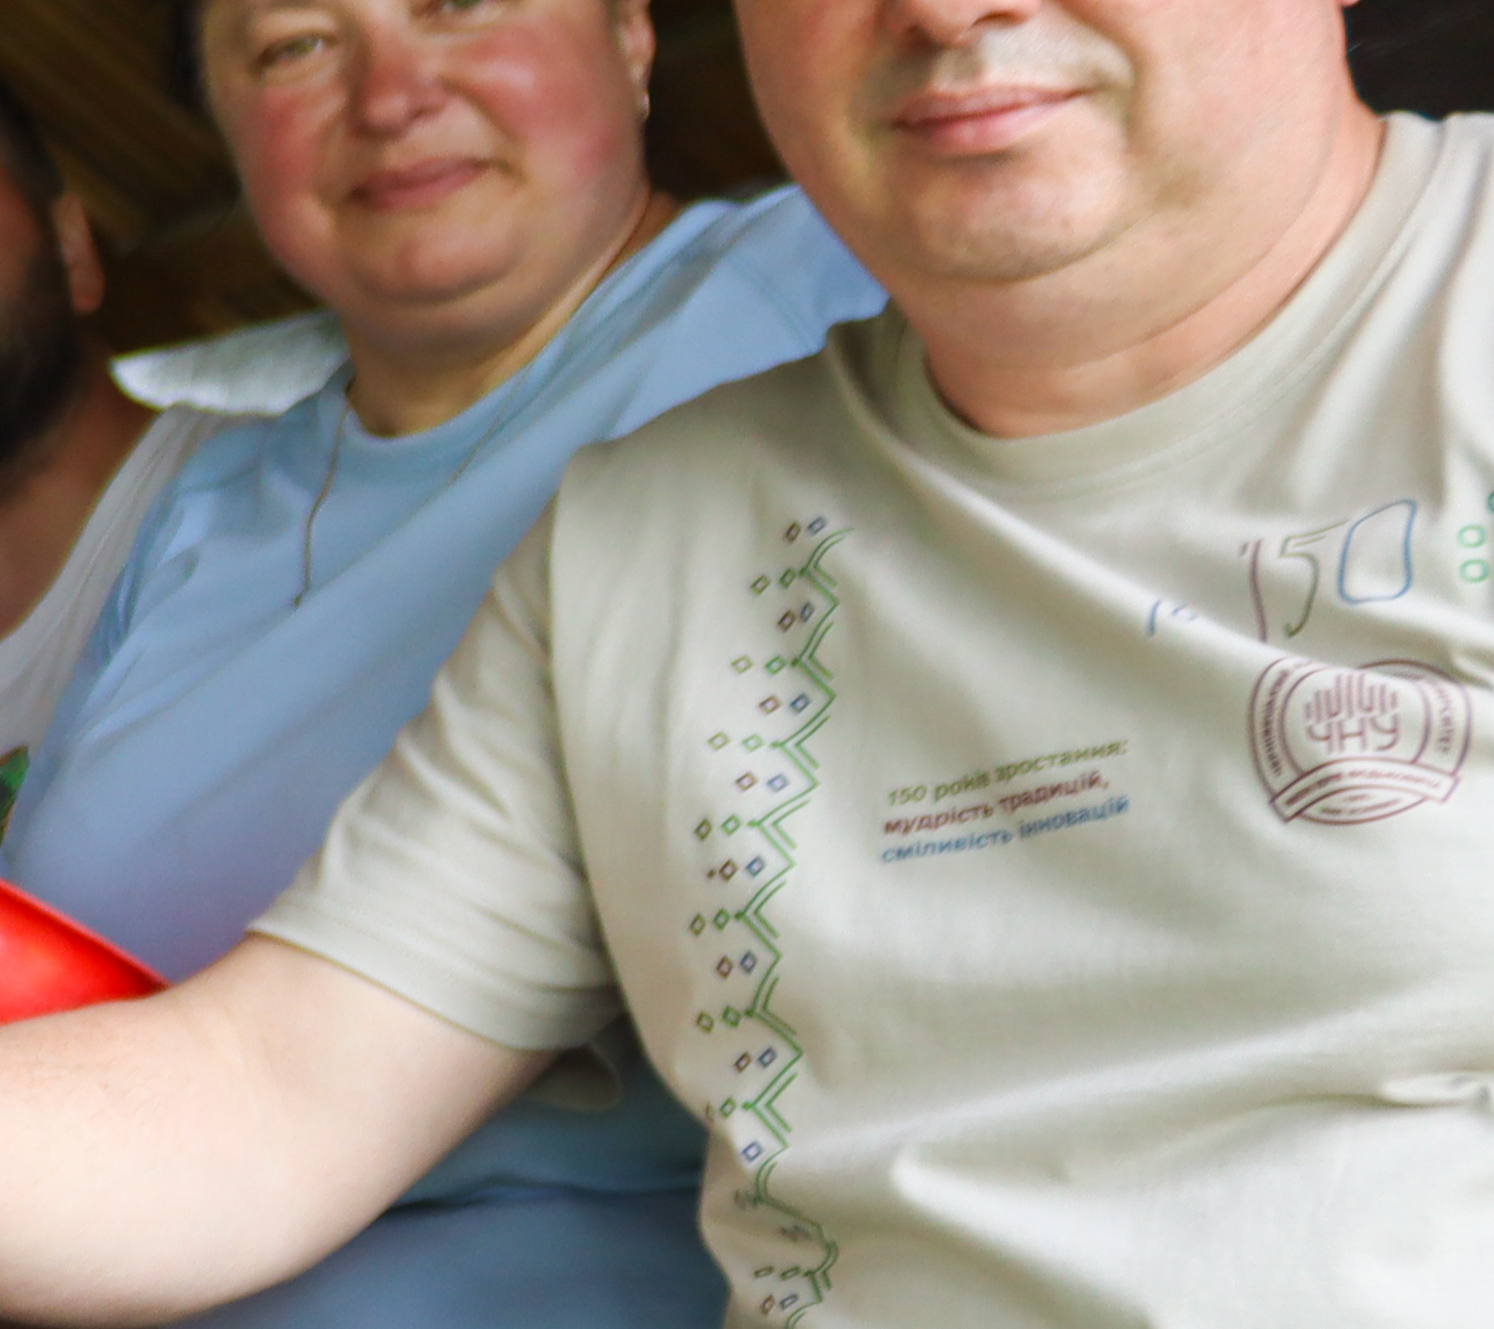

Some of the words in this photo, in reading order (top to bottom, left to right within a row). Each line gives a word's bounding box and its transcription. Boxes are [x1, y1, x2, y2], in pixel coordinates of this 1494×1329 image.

[1239, 498, 1417, 643] 150
[883, 802, 994, 836] мудрість
[998, 769, 1110, 816] традицій,
[887, 784, 927, 806] 150
[932, 771, 990, 803] років
[995, 739, 1129, 784] зростання:
[881, 828, 1013, 864] сміливість
[1018, 792, 1131, 839] інновацій
